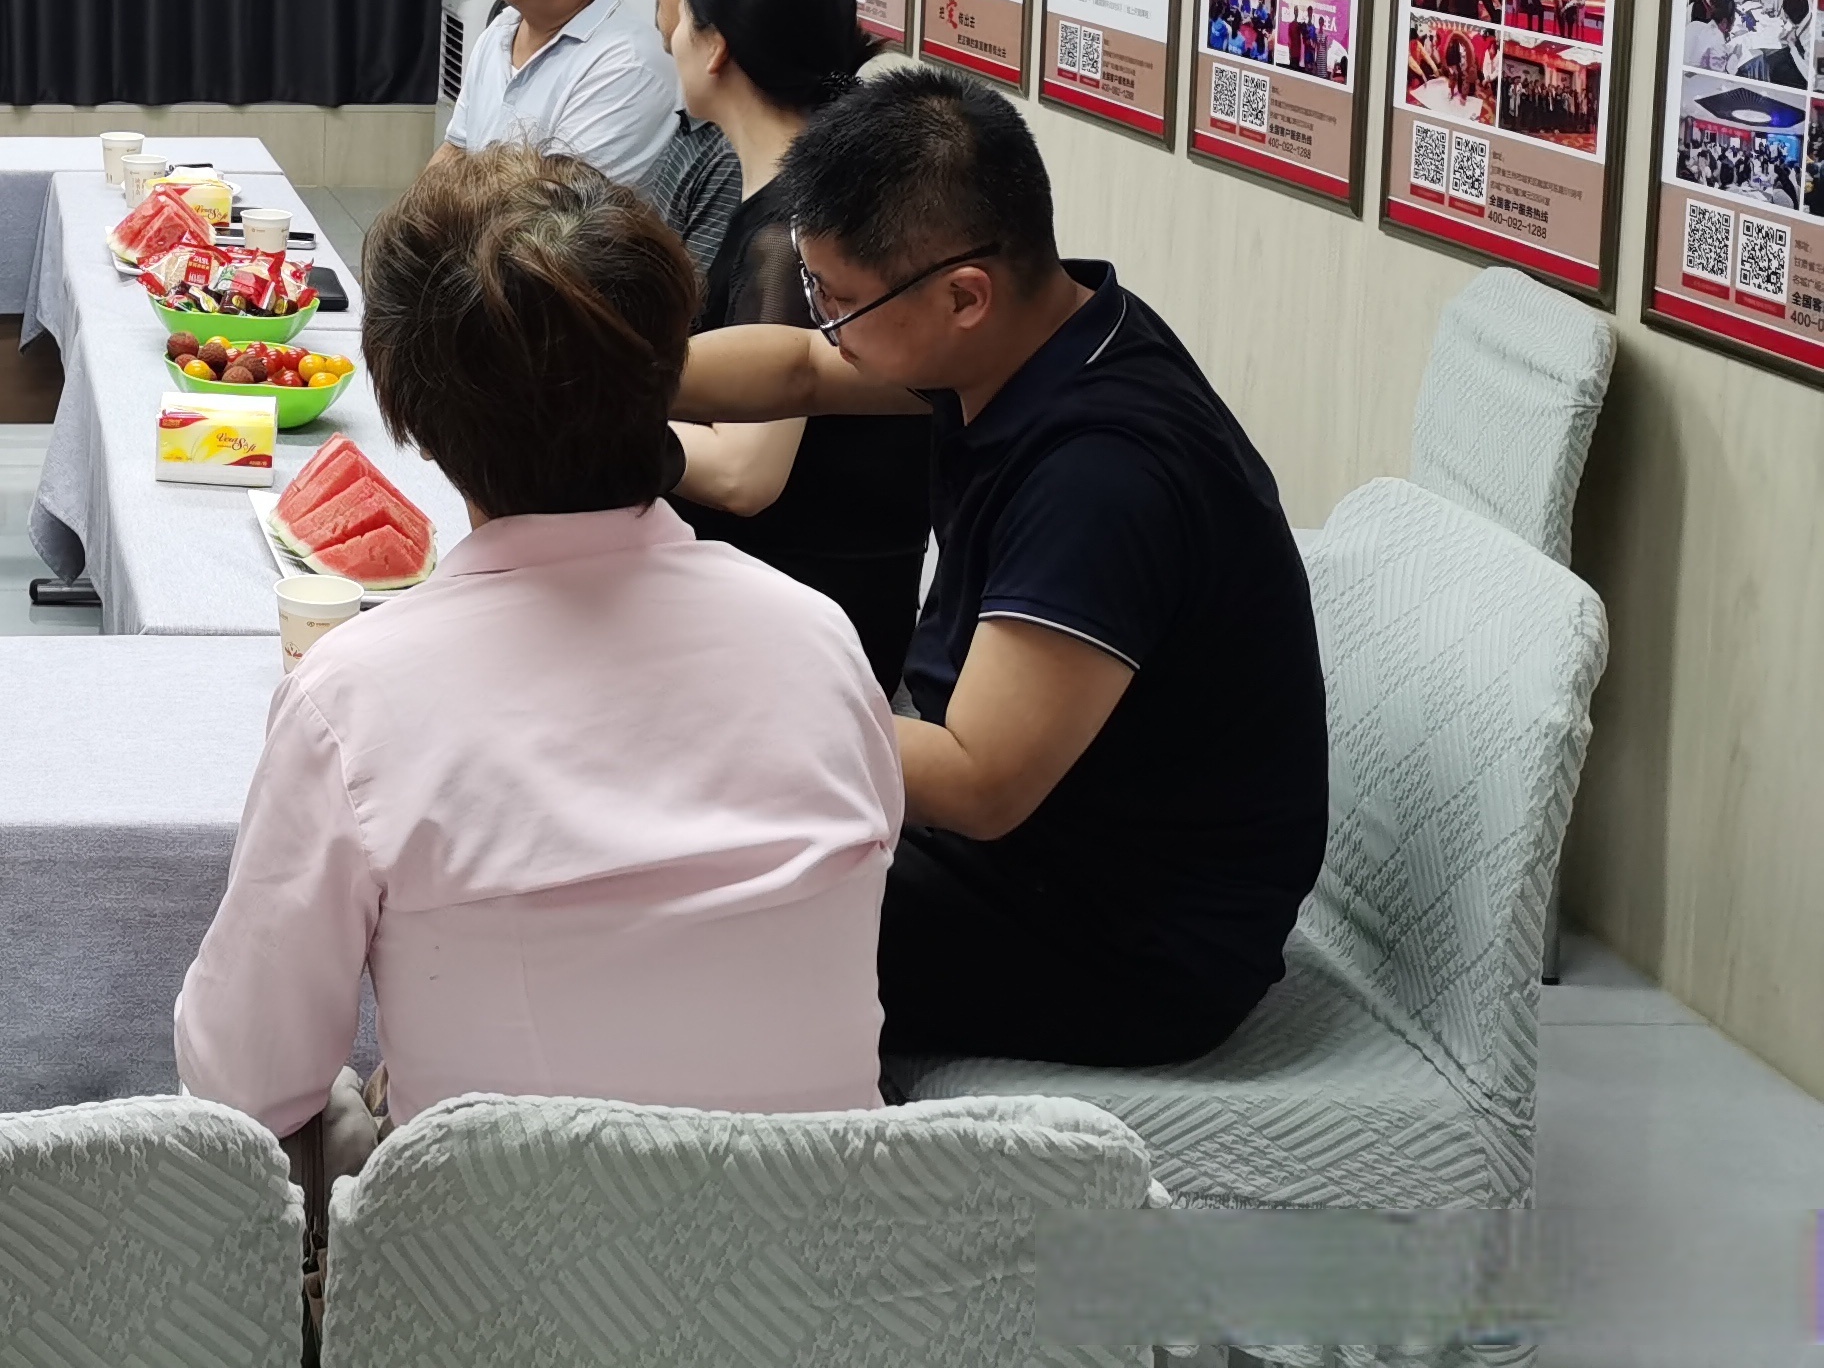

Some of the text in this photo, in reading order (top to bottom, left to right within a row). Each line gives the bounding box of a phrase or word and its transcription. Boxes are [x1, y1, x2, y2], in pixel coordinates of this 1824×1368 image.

[1488, 194, 1549, 224] 全国客户服务热线
